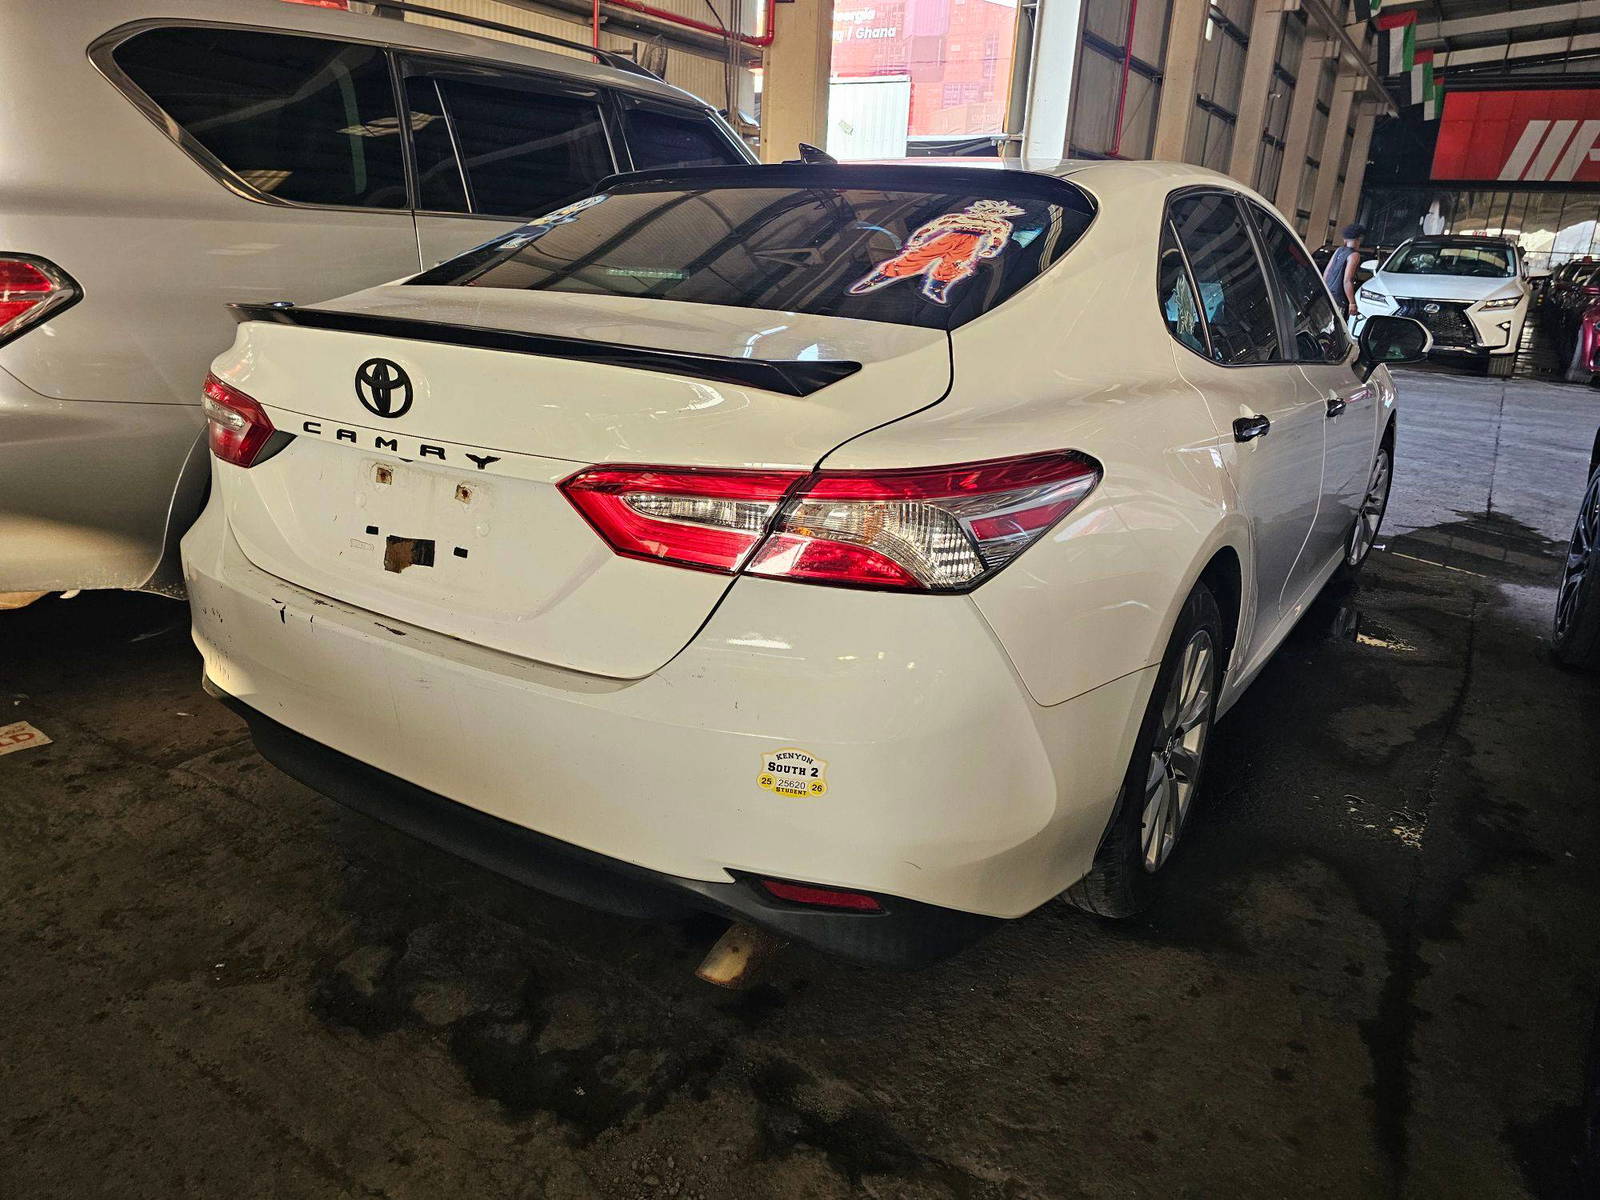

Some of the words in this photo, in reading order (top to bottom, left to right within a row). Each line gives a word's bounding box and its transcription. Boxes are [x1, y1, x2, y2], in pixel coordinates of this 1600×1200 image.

[856, 25, 897, 39] Ghana
[302, 421, 501, 470] CAMRY
[776, 752, 814, 765] KENYON
[767, 761, 806, 776] SOUTH
[810, 767, 819, 777] 2
[761, 777, 772, 785] 25
[778, 778, 806, 789] 25620
[775, 786, 807, 796] STUDENT
[811, 784, 823, 792] 26
